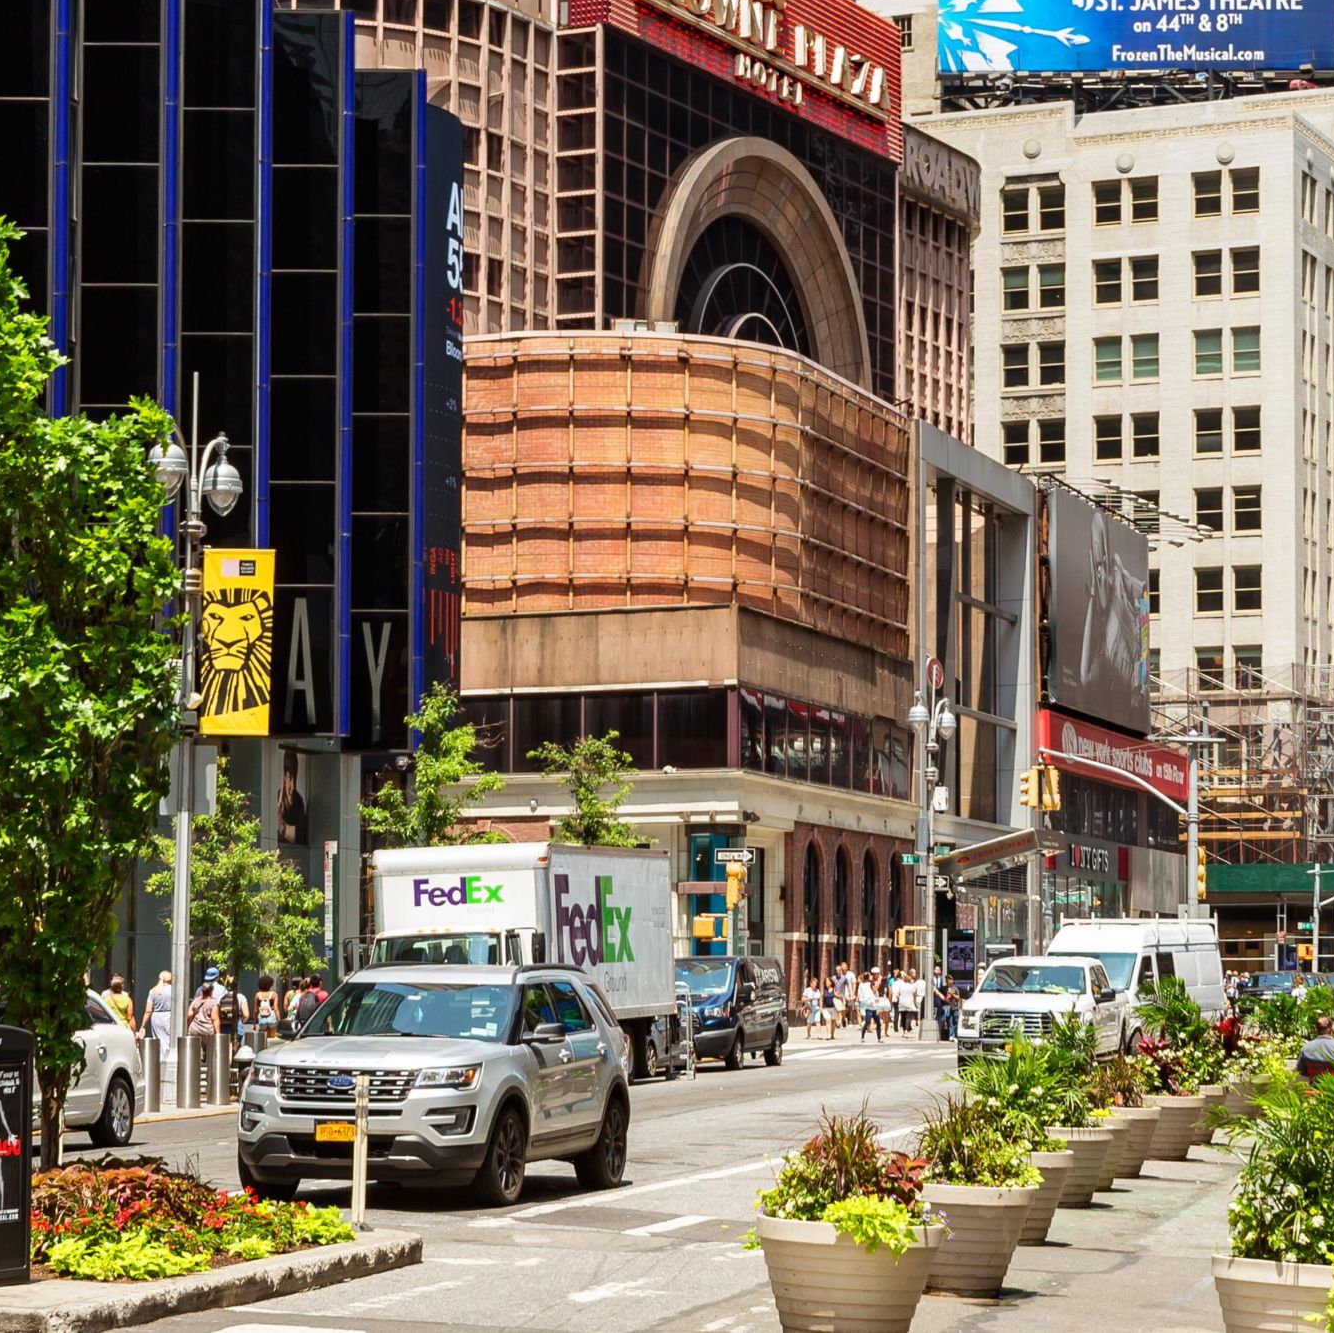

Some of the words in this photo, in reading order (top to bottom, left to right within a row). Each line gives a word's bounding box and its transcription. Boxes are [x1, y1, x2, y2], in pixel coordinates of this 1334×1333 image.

[1133, 19, 1151, 33] on
[1156, 14, 1194, 33] 44TH
[1198, 14, 1212, 33] &
[1216, 13, 1242, 32] 8TH
[794, 24, 891, 111] PLAZA
[1112, 44, 1264, 62] FrozenTheMusical.com
[733, 53, 805, 108] HOTEL
[1078, 736, 1094, 757] new
[1094, 738, 1111, 762] york
[1112, 746, 1133, 770] sports
[1135, 749, 1152, 777] clubs
[1080, 846, 1092, 868] NY
[1092, 849, 1109, 872] GIFTS
[413, 876, 505, 907] FedEx
[554, 873, 635, 967] FedEx
